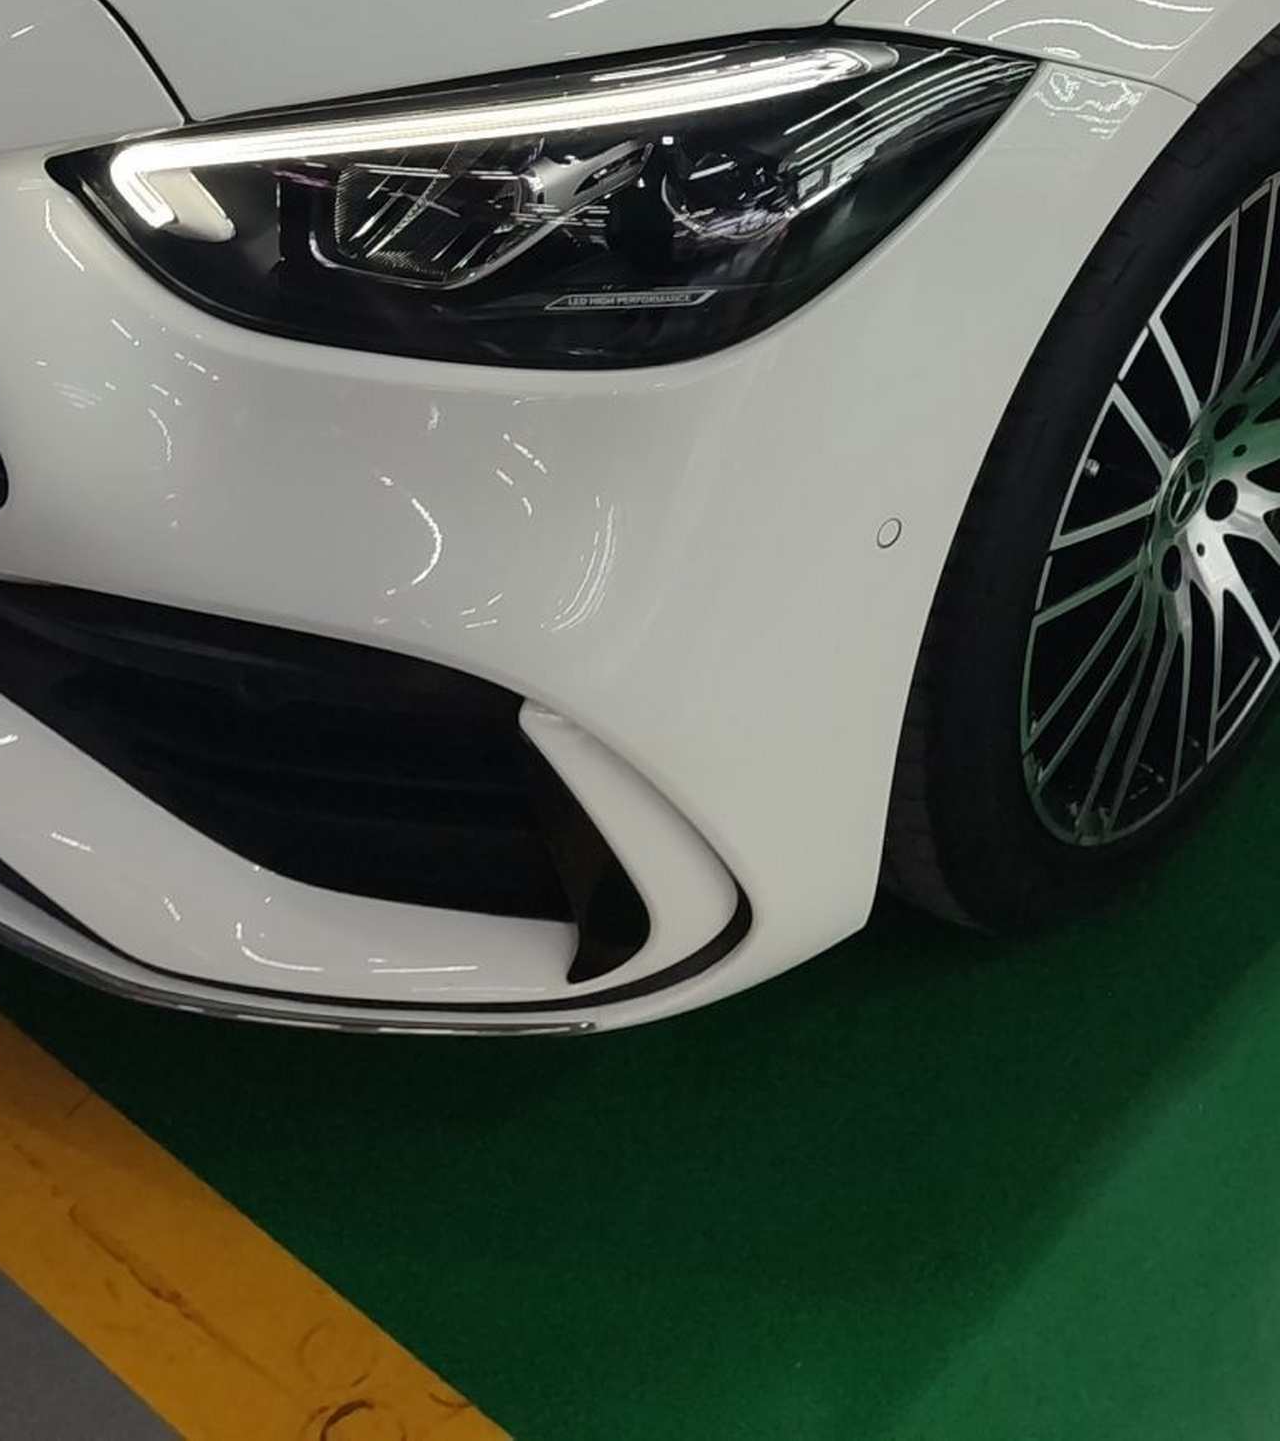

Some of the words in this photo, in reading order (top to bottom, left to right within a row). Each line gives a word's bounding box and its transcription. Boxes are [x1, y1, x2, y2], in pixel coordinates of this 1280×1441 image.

[568, 297, 587, 306] LED
[589, 297, 615, 306] HIGH
[617, 294, 692, 305] PERFORMANCE
